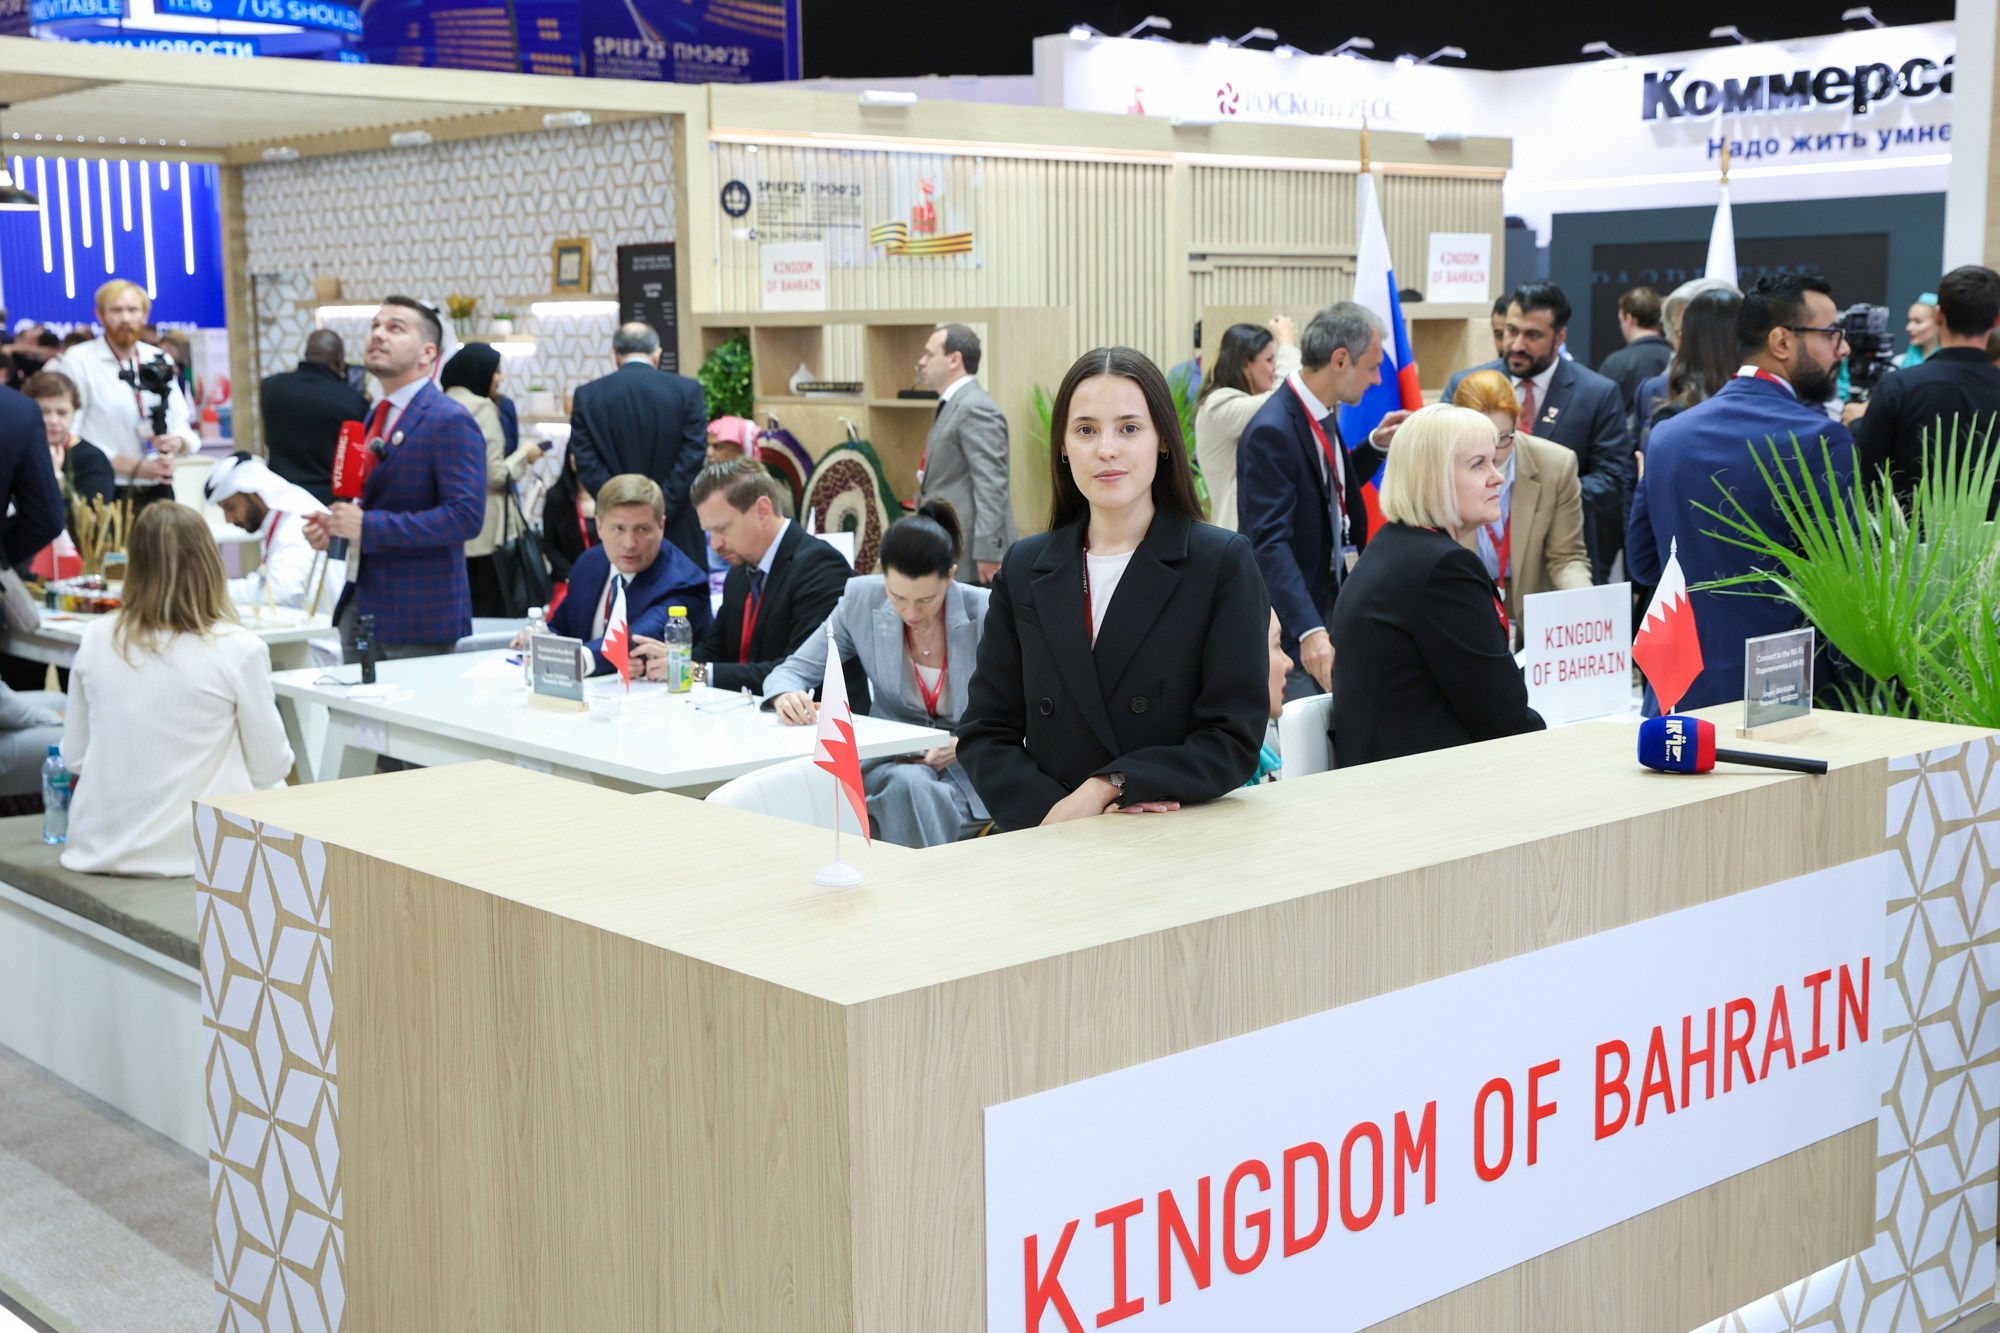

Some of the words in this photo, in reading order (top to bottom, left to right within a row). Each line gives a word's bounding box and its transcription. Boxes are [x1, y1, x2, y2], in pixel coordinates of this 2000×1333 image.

[251, 0, 284, 20] US
[1708, 136, 1780, 159] Надо
[1790, 130, 1868, 154] жить
[773, 261, 814, 275] KINGDOM
[1440, 251, 1480, 266] KINGDOM
[767, 278, 778, 292] OF
[781, 277, 821, 292] BAHRAIN
[1432, 269, 1443, 284] OF
[1447, 269, 1486, 284] BAHRAIN
[1545, 619, 1613, 650] KINGDOM
[1533, 662, 1552, 687] OF
[1558, 651, 1625, 682] BAHRAIN
[1023, 1101, 1437, 1333] KINGDOM
[1474, 1058, 1561, 1182] OF
[1595, 956, 1870, 1141] BAHRAIN
